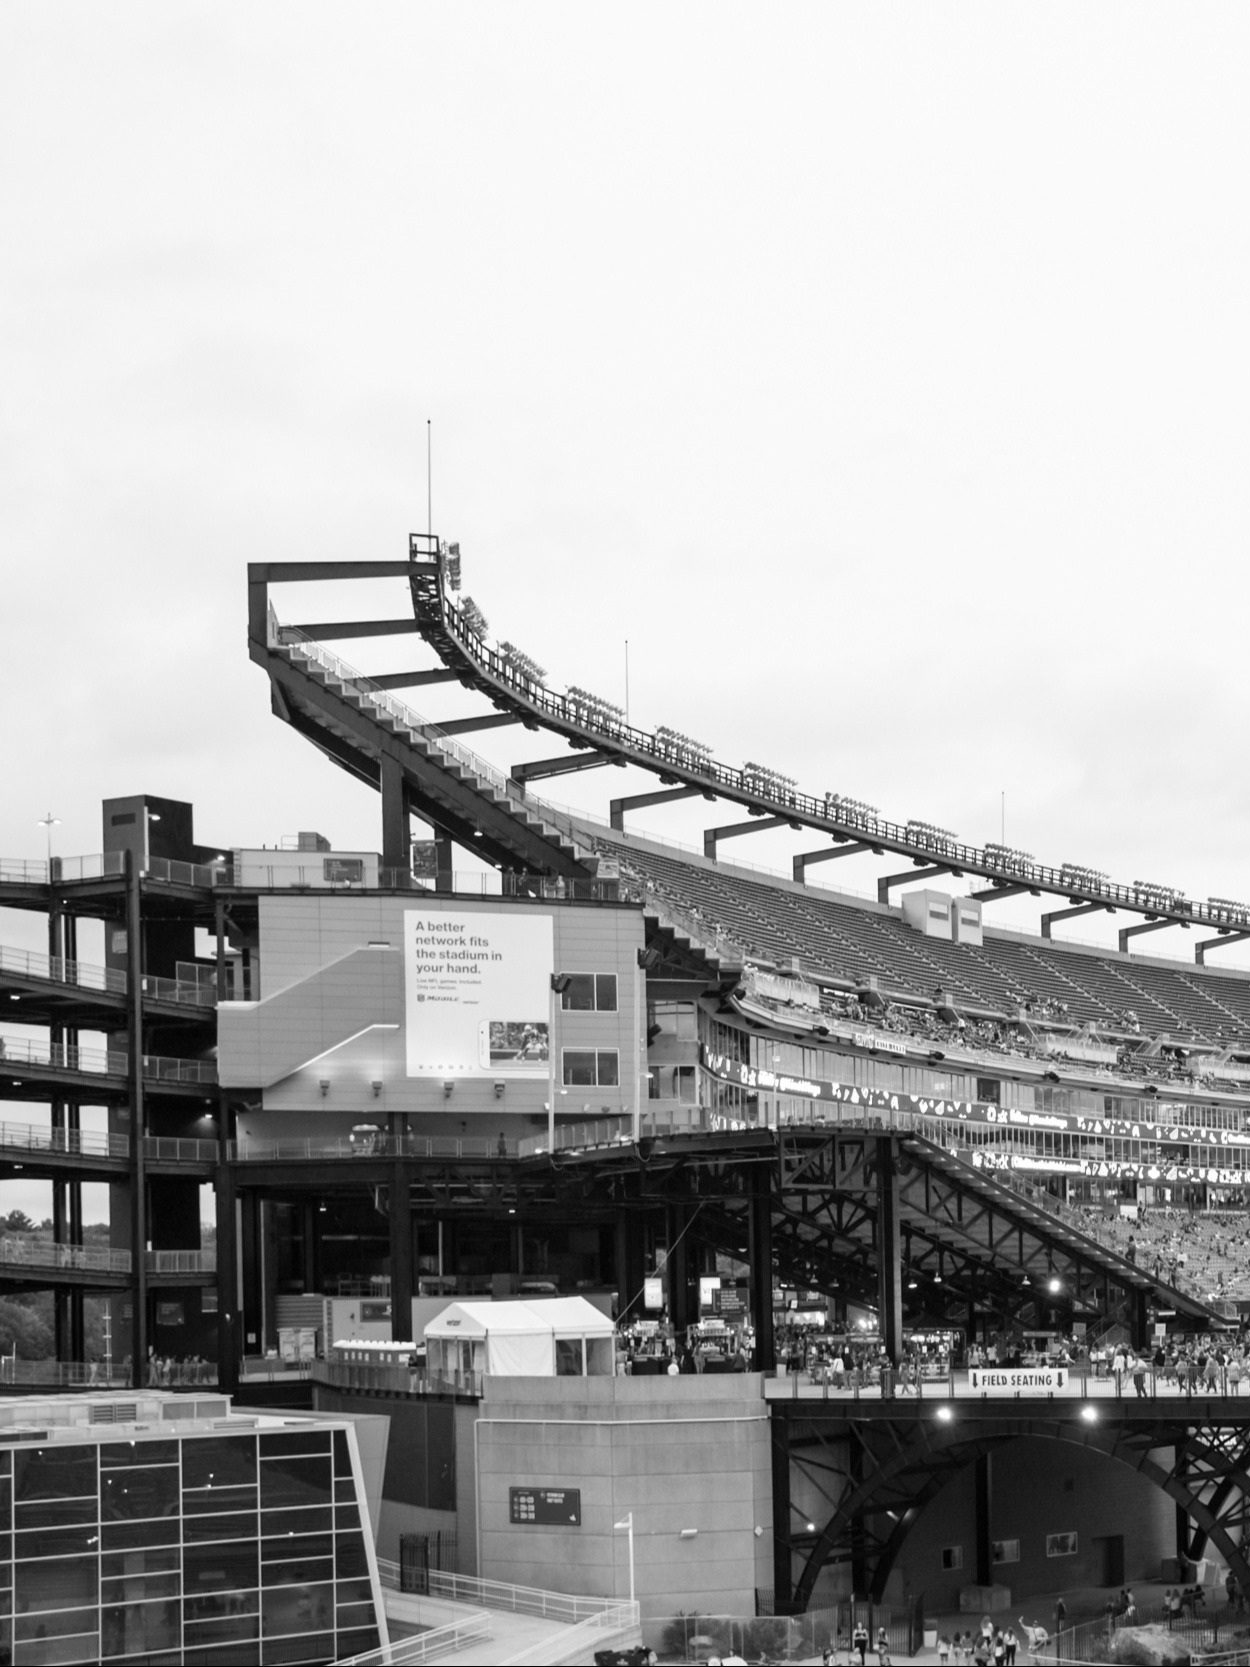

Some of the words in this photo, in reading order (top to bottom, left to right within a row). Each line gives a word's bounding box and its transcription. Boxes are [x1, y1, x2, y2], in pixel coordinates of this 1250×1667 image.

[416, 920, 424, 931] A
[427, 921, 465, 932] better
[416, 936, 466, 946] network
[469, 936, 489, 947] fits
[416, 949, 436, 959] the
[439, 949, 489, 960] stadium
[491, 950, 502, 960] in
[416, 964, 444, 974] your
[446, 963, 481, 974] hand.
[982, 1375, 1007, 1386] FIELD
[1011, 1375, 1052, 1386] SEATING
